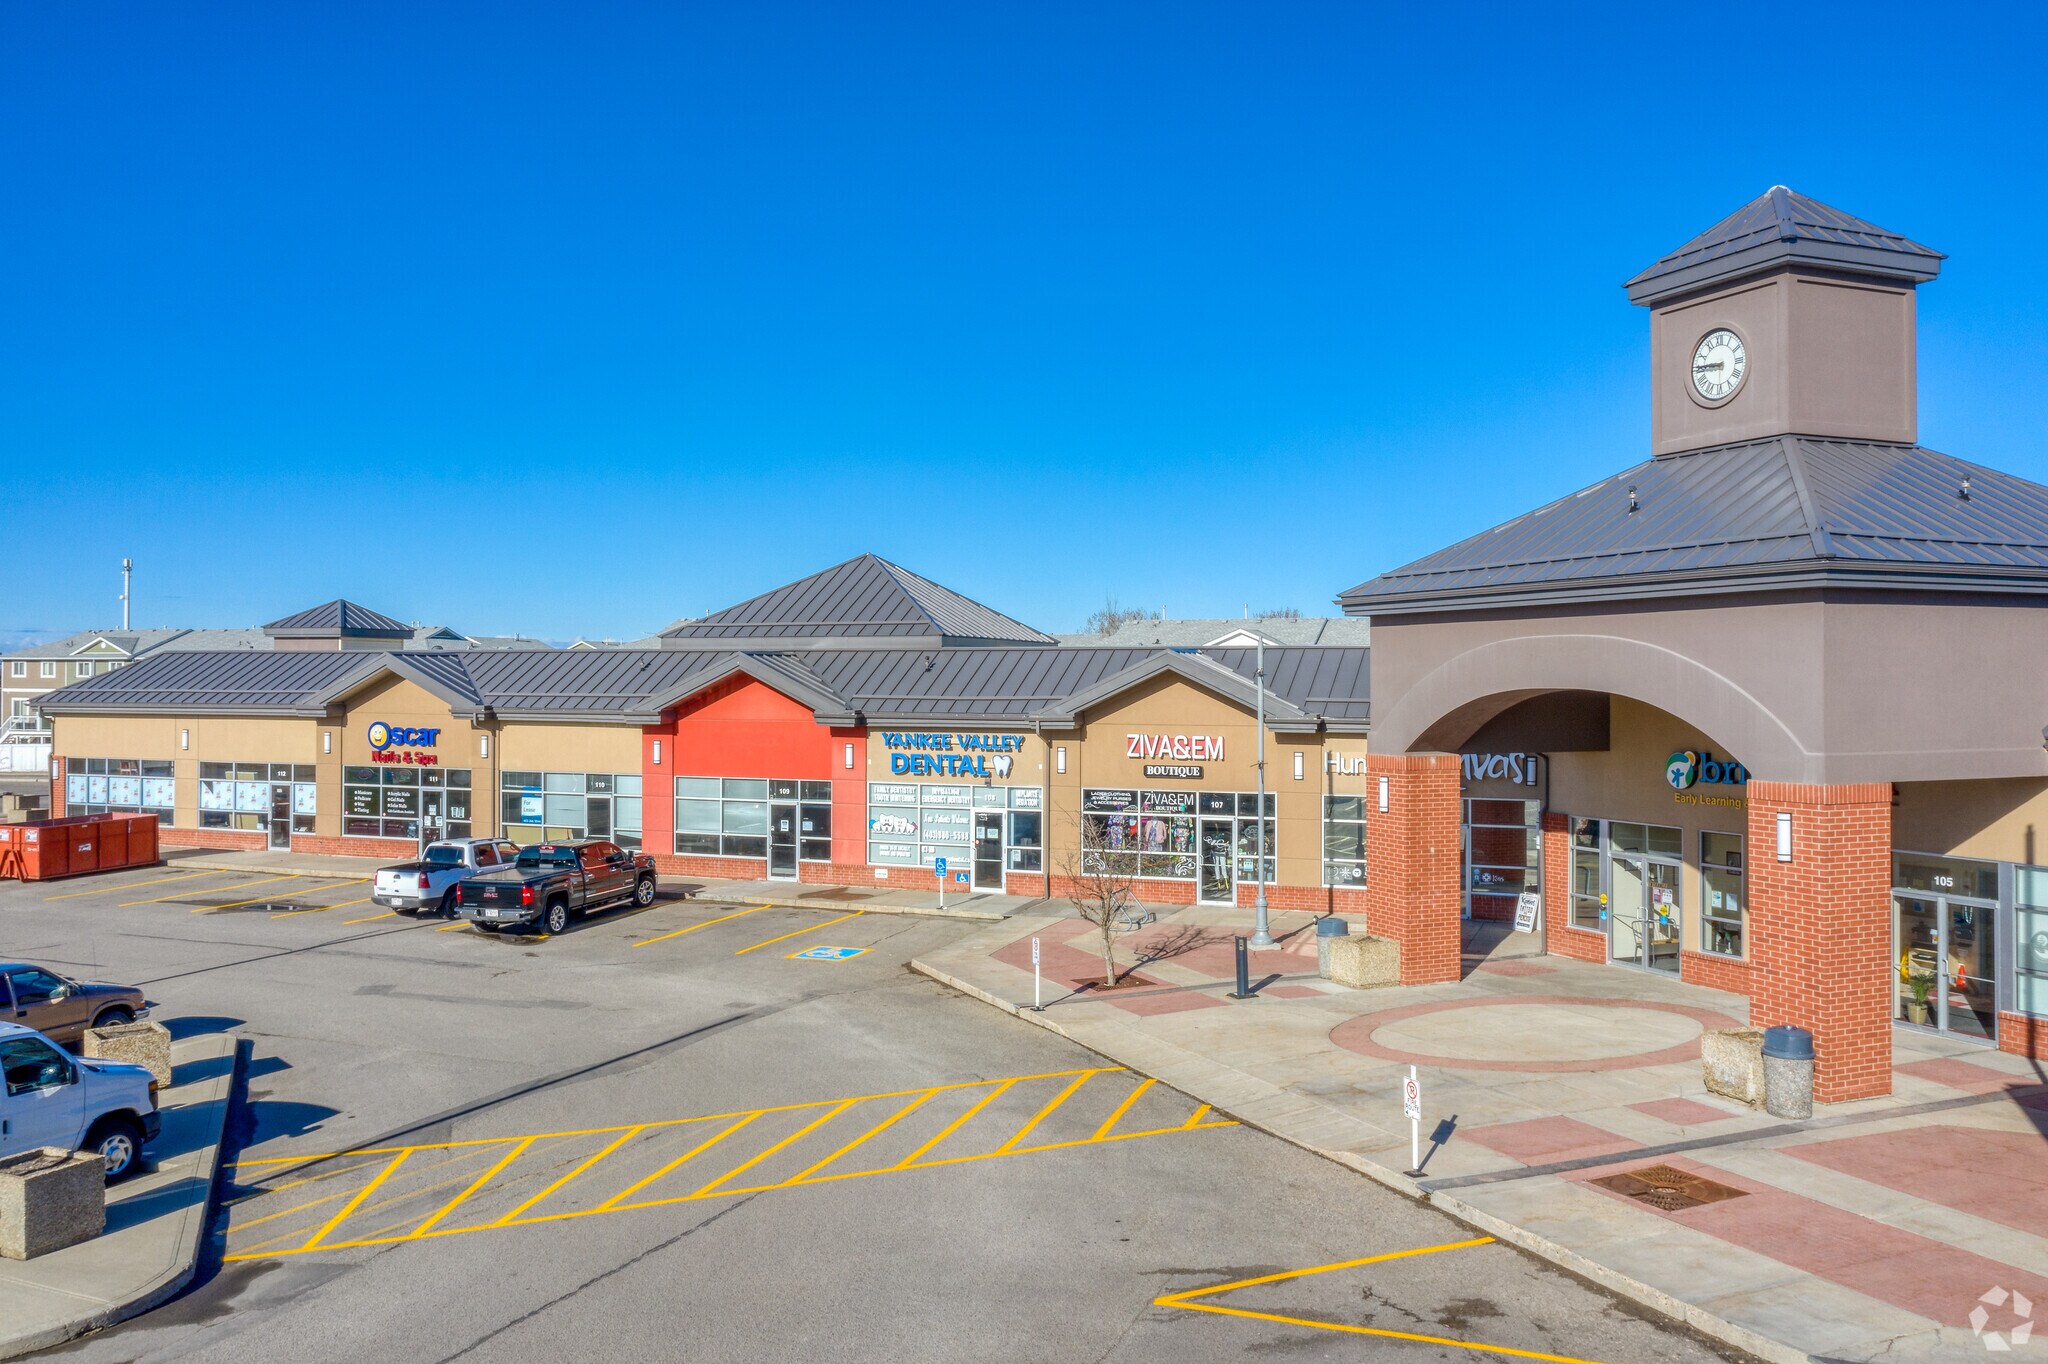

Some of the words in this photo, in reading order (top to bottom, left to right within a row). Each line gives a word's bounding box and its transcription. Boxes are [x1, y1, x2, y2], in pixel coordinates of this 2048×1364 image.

[368, 721, 440, 751] Oscar
[881, 732, 951, 749] YANKEE
[956, 734, 1024, 750] VALLEY
[1126, 733, 1224, 760] ZIVA&EM
[372, 751, 400, 763] Nails
[402, 752, 412, 763] &
[414, 752, 437, 765] Spa
[891, 752, 990, 776] DENTAL
[1146, 765, 1201, 777] BOUTIQUE
[1144, 793, 1194, 805] ZIVA&EM
[1210, 801, 1224, 809] 107
[1674, 792, 1697, 805] Early
[1700, 794, 1741, 809] Learning
[1934, 875, 1954, 887] 105
